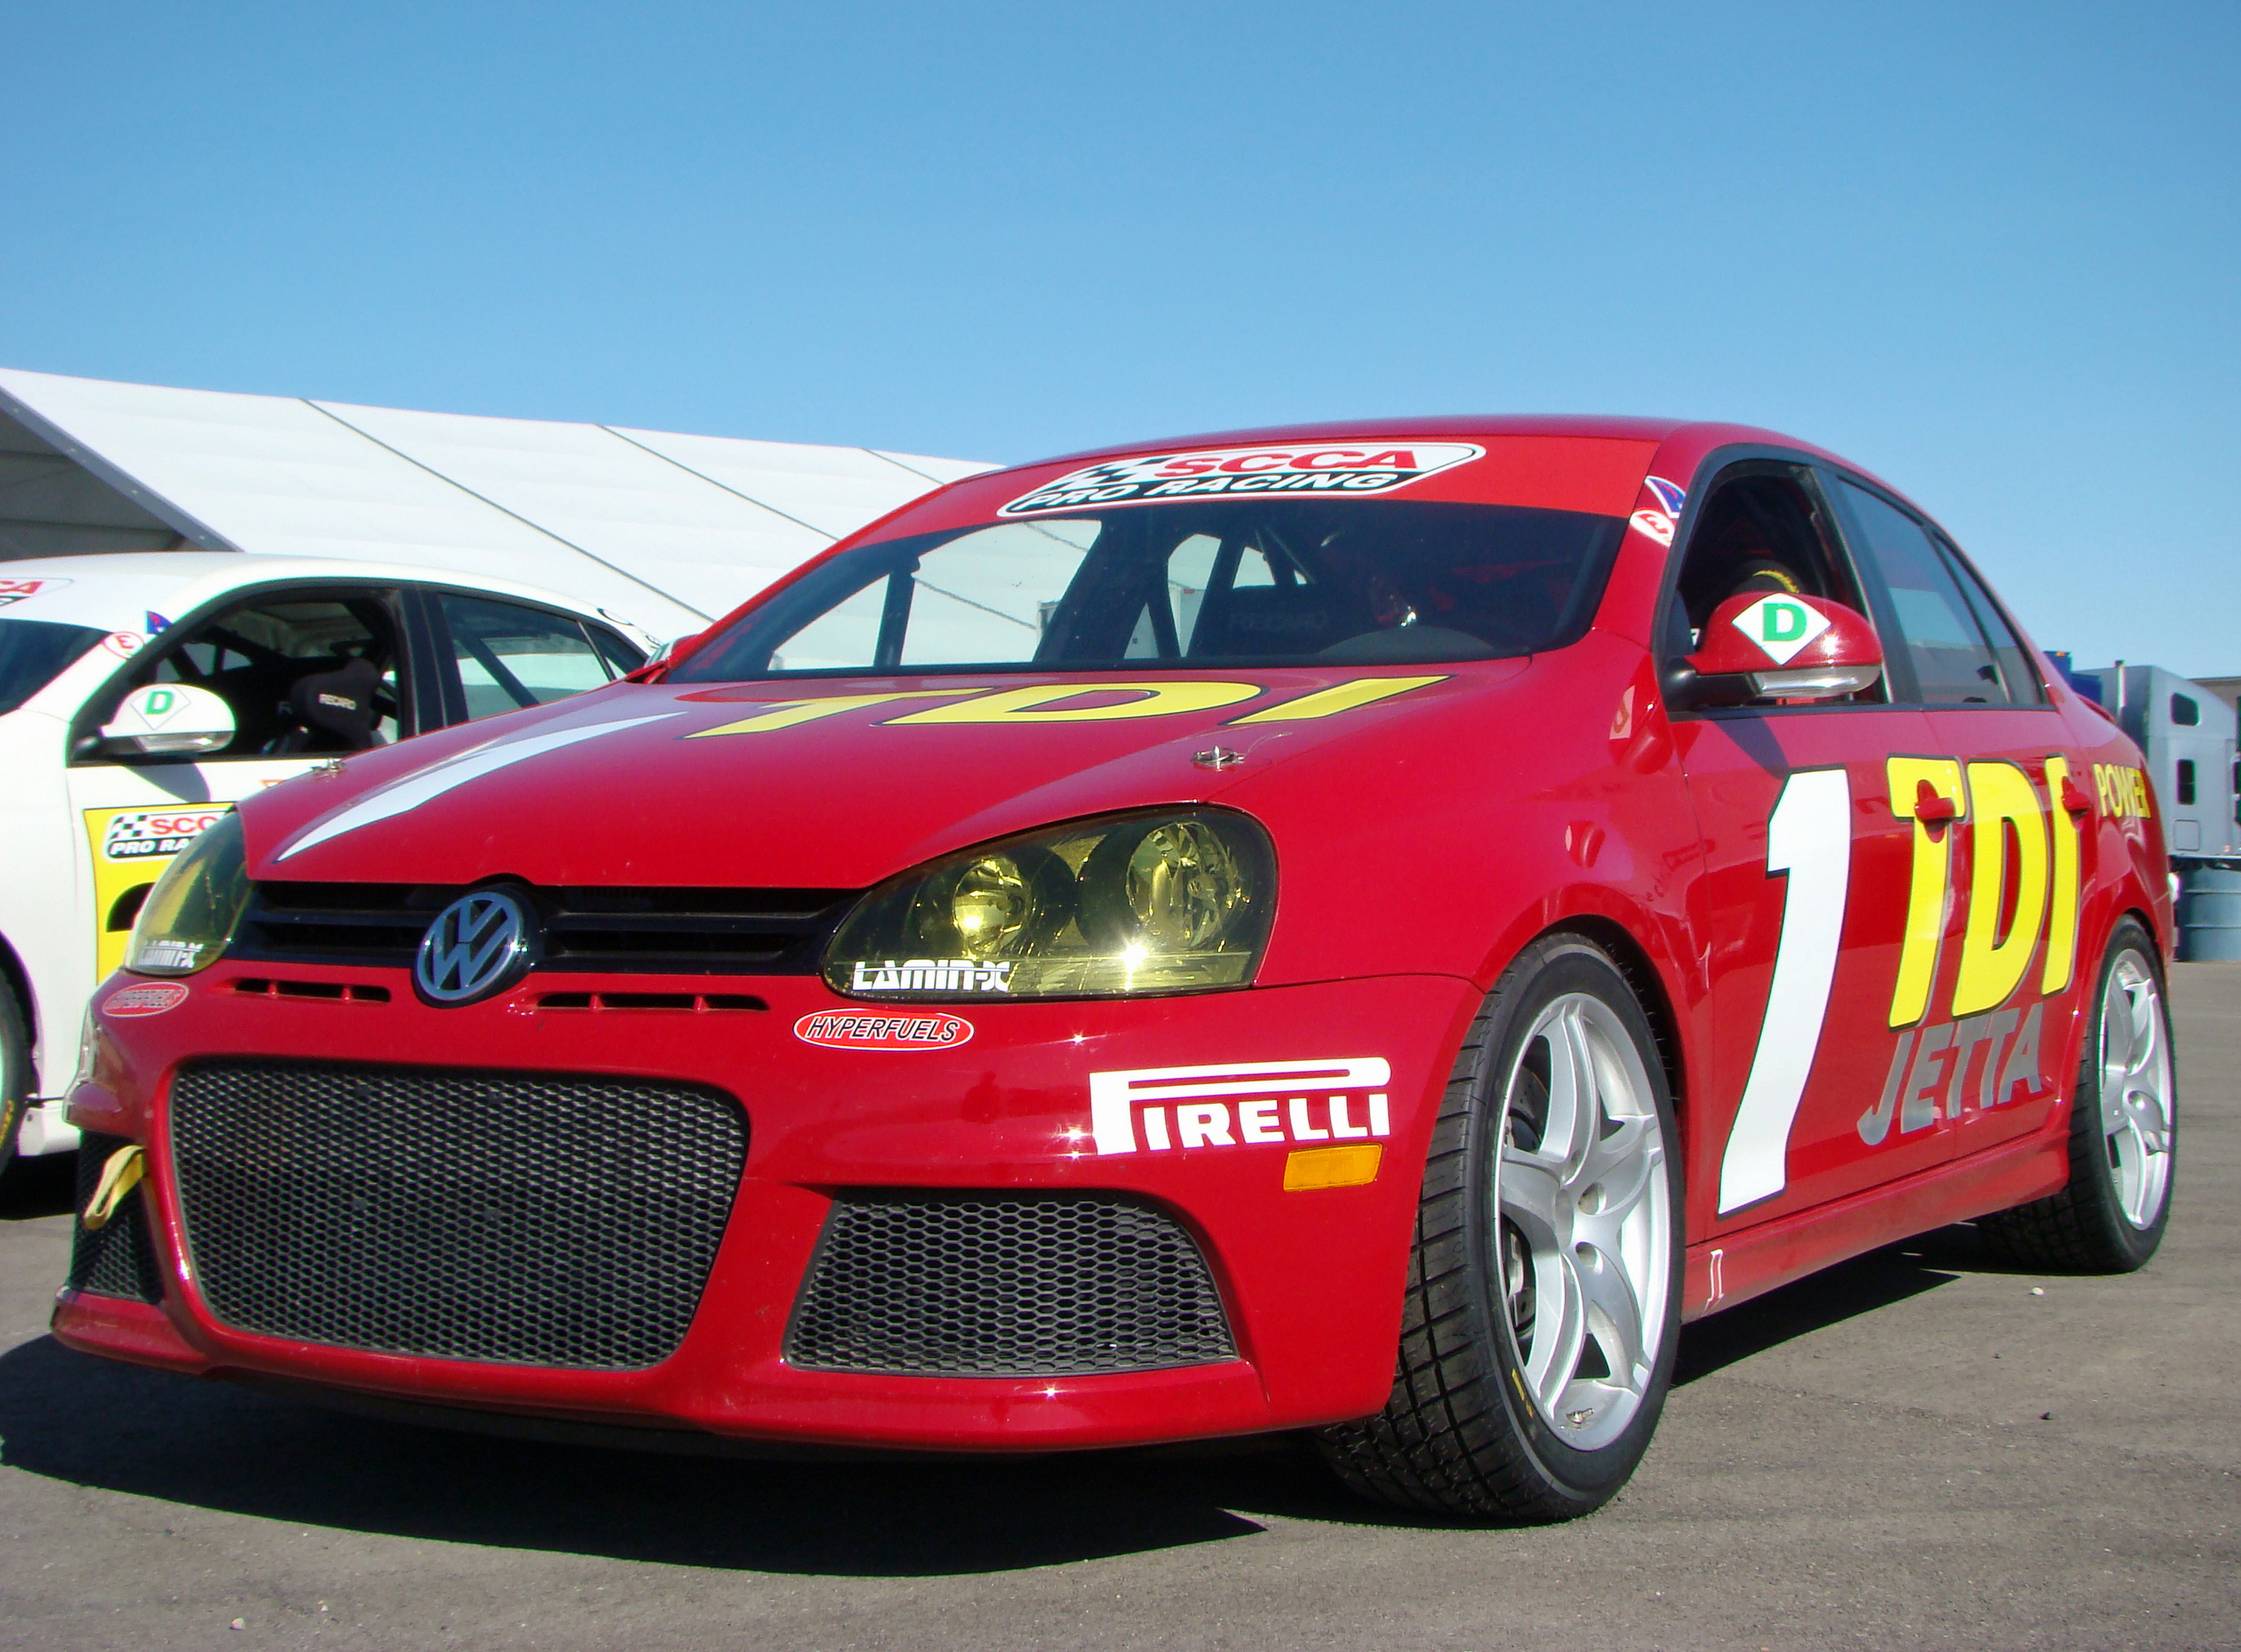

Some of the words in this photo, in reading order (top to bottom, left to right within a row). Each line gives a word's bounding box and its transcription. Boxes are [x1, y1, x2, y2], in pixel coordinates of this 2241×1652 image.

[1153, 449, 1419, 478] SCCA
[1014, 483, 1141, 512] PRO
[1143, 473, 1400, 498] RACING
[1763, 603, 1807, 642] D
[145, 690, 174, 715] D
[675, 674, 1455, 739] TDI
[108, 840, 156, 856] PRO
[1716, 762, 1852, 1221] 1
[1886, 753, 2082, 1033] TDI
[804, 1016, 959, 1042] HYPERFUELS
[1855, 1003, 2042, 1146] JETTA
[1089, 1056, 1392, 1156] PIRELLI
